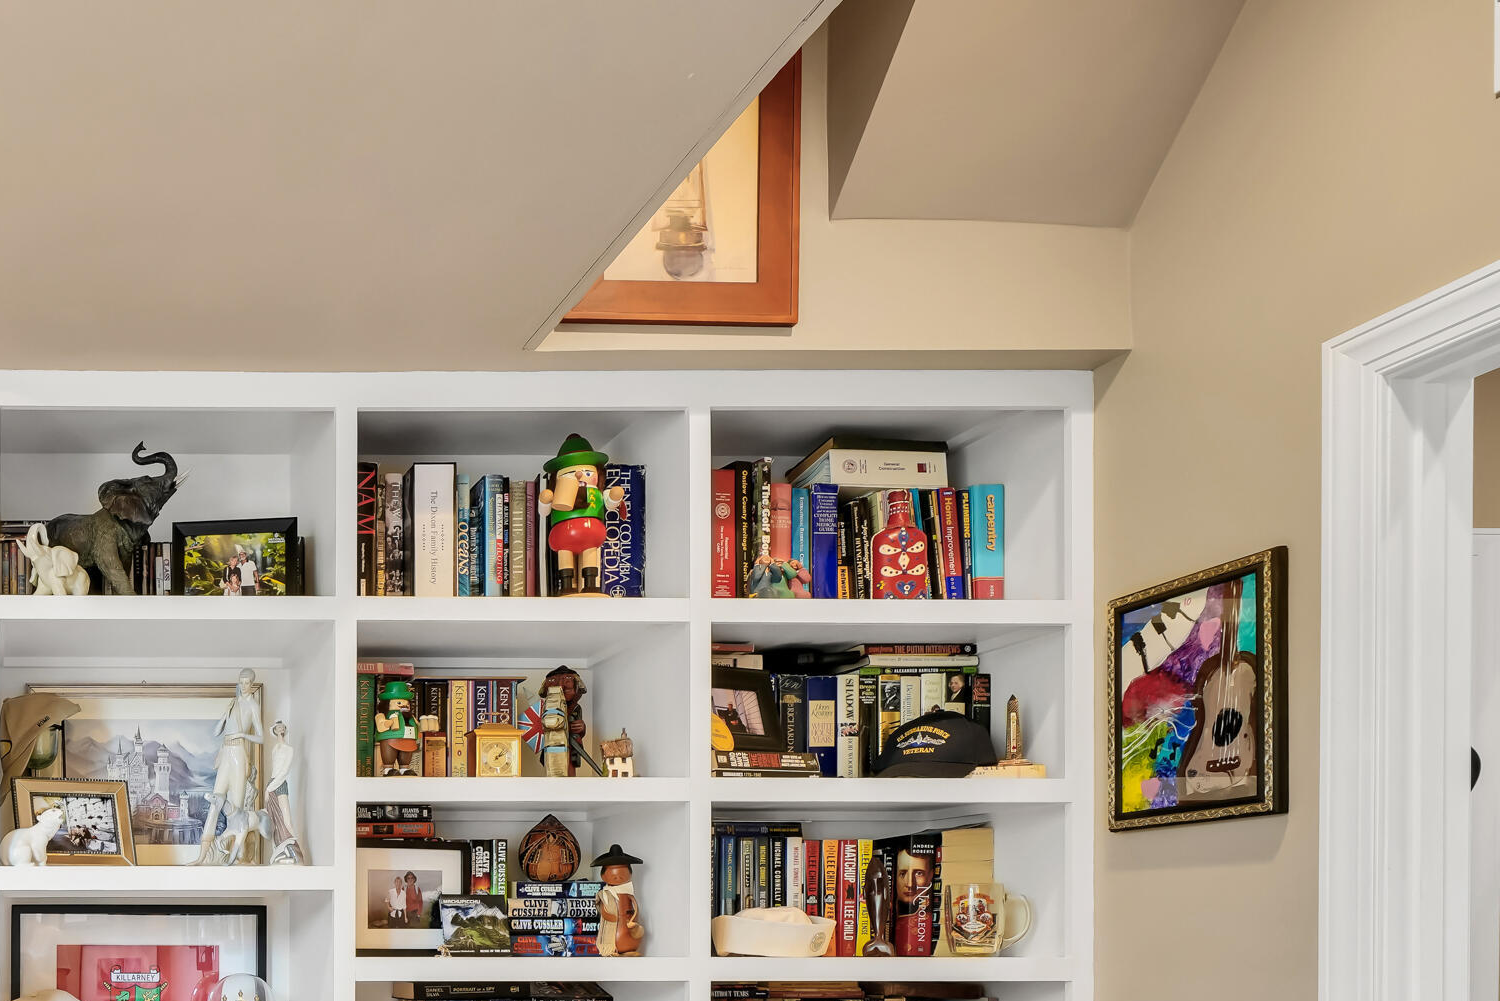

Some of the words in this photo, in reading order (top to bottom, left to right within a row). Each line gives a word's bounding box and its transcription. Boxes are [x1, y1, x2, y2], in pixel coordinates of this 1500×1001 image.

[357, 470, 376, 537] NAM
[430, 490, 438, 504] The
[740, 496, 748, 520] County
[430, 506, 438, 529] Dixon
[944, 502, 953, 525] Home
[962, 492, 971, 538] PLUMBING
[986, 494, 997, 552] carpentry
[428, 530, 438, 556] Family
[740, 522, 748, 551] Heritage
[458, 521, 469, 576] OCEANS
[945, 526, 956, 576] Improvement
[428, 558, 438, 585] History
[359, 680, 370, 699] KEN
[455, 685, 465, 705] KEN
[499, 686, 509, 707] KEN
[845, 678, 855, 721] SHADOW
[359, 702, 370, 744] FOLLETT
[455, 707, 465, 748] FOLLETT
[904, 725, 933, 737] SUBMARINE
[932, 727, 951, 740] FORCE
[902, 747, 935, 755] VETERAN
[498, 841, 506, 862] CLIVE
[774, 841, 782, 868] MICHAEL
[808, 855, 817, 868] LEE
[826, 855, 835, 868] LEE
[844, 844, 856, 883] MATCHUP
[498, 863, 506, 895] CUSSLER
[774, 870, 782, 902] CONNELLY
[808, 870, 817, 892] CHILD
[826, 870, 836, 891] CHILD
[512, 908, 549, 917] CUSSLER
[523, 900, 549, 908] CLIVE
[844, 905, 855, 918] LEE
[912, 881, 933, 942] NAPOLEON
[512, 920, 532, 930] CLIVE
[533, 920, 564, 930] CUSSLER
[582, 922, 597, 932] LOST
[844, 919, 855, 941] CHILD
